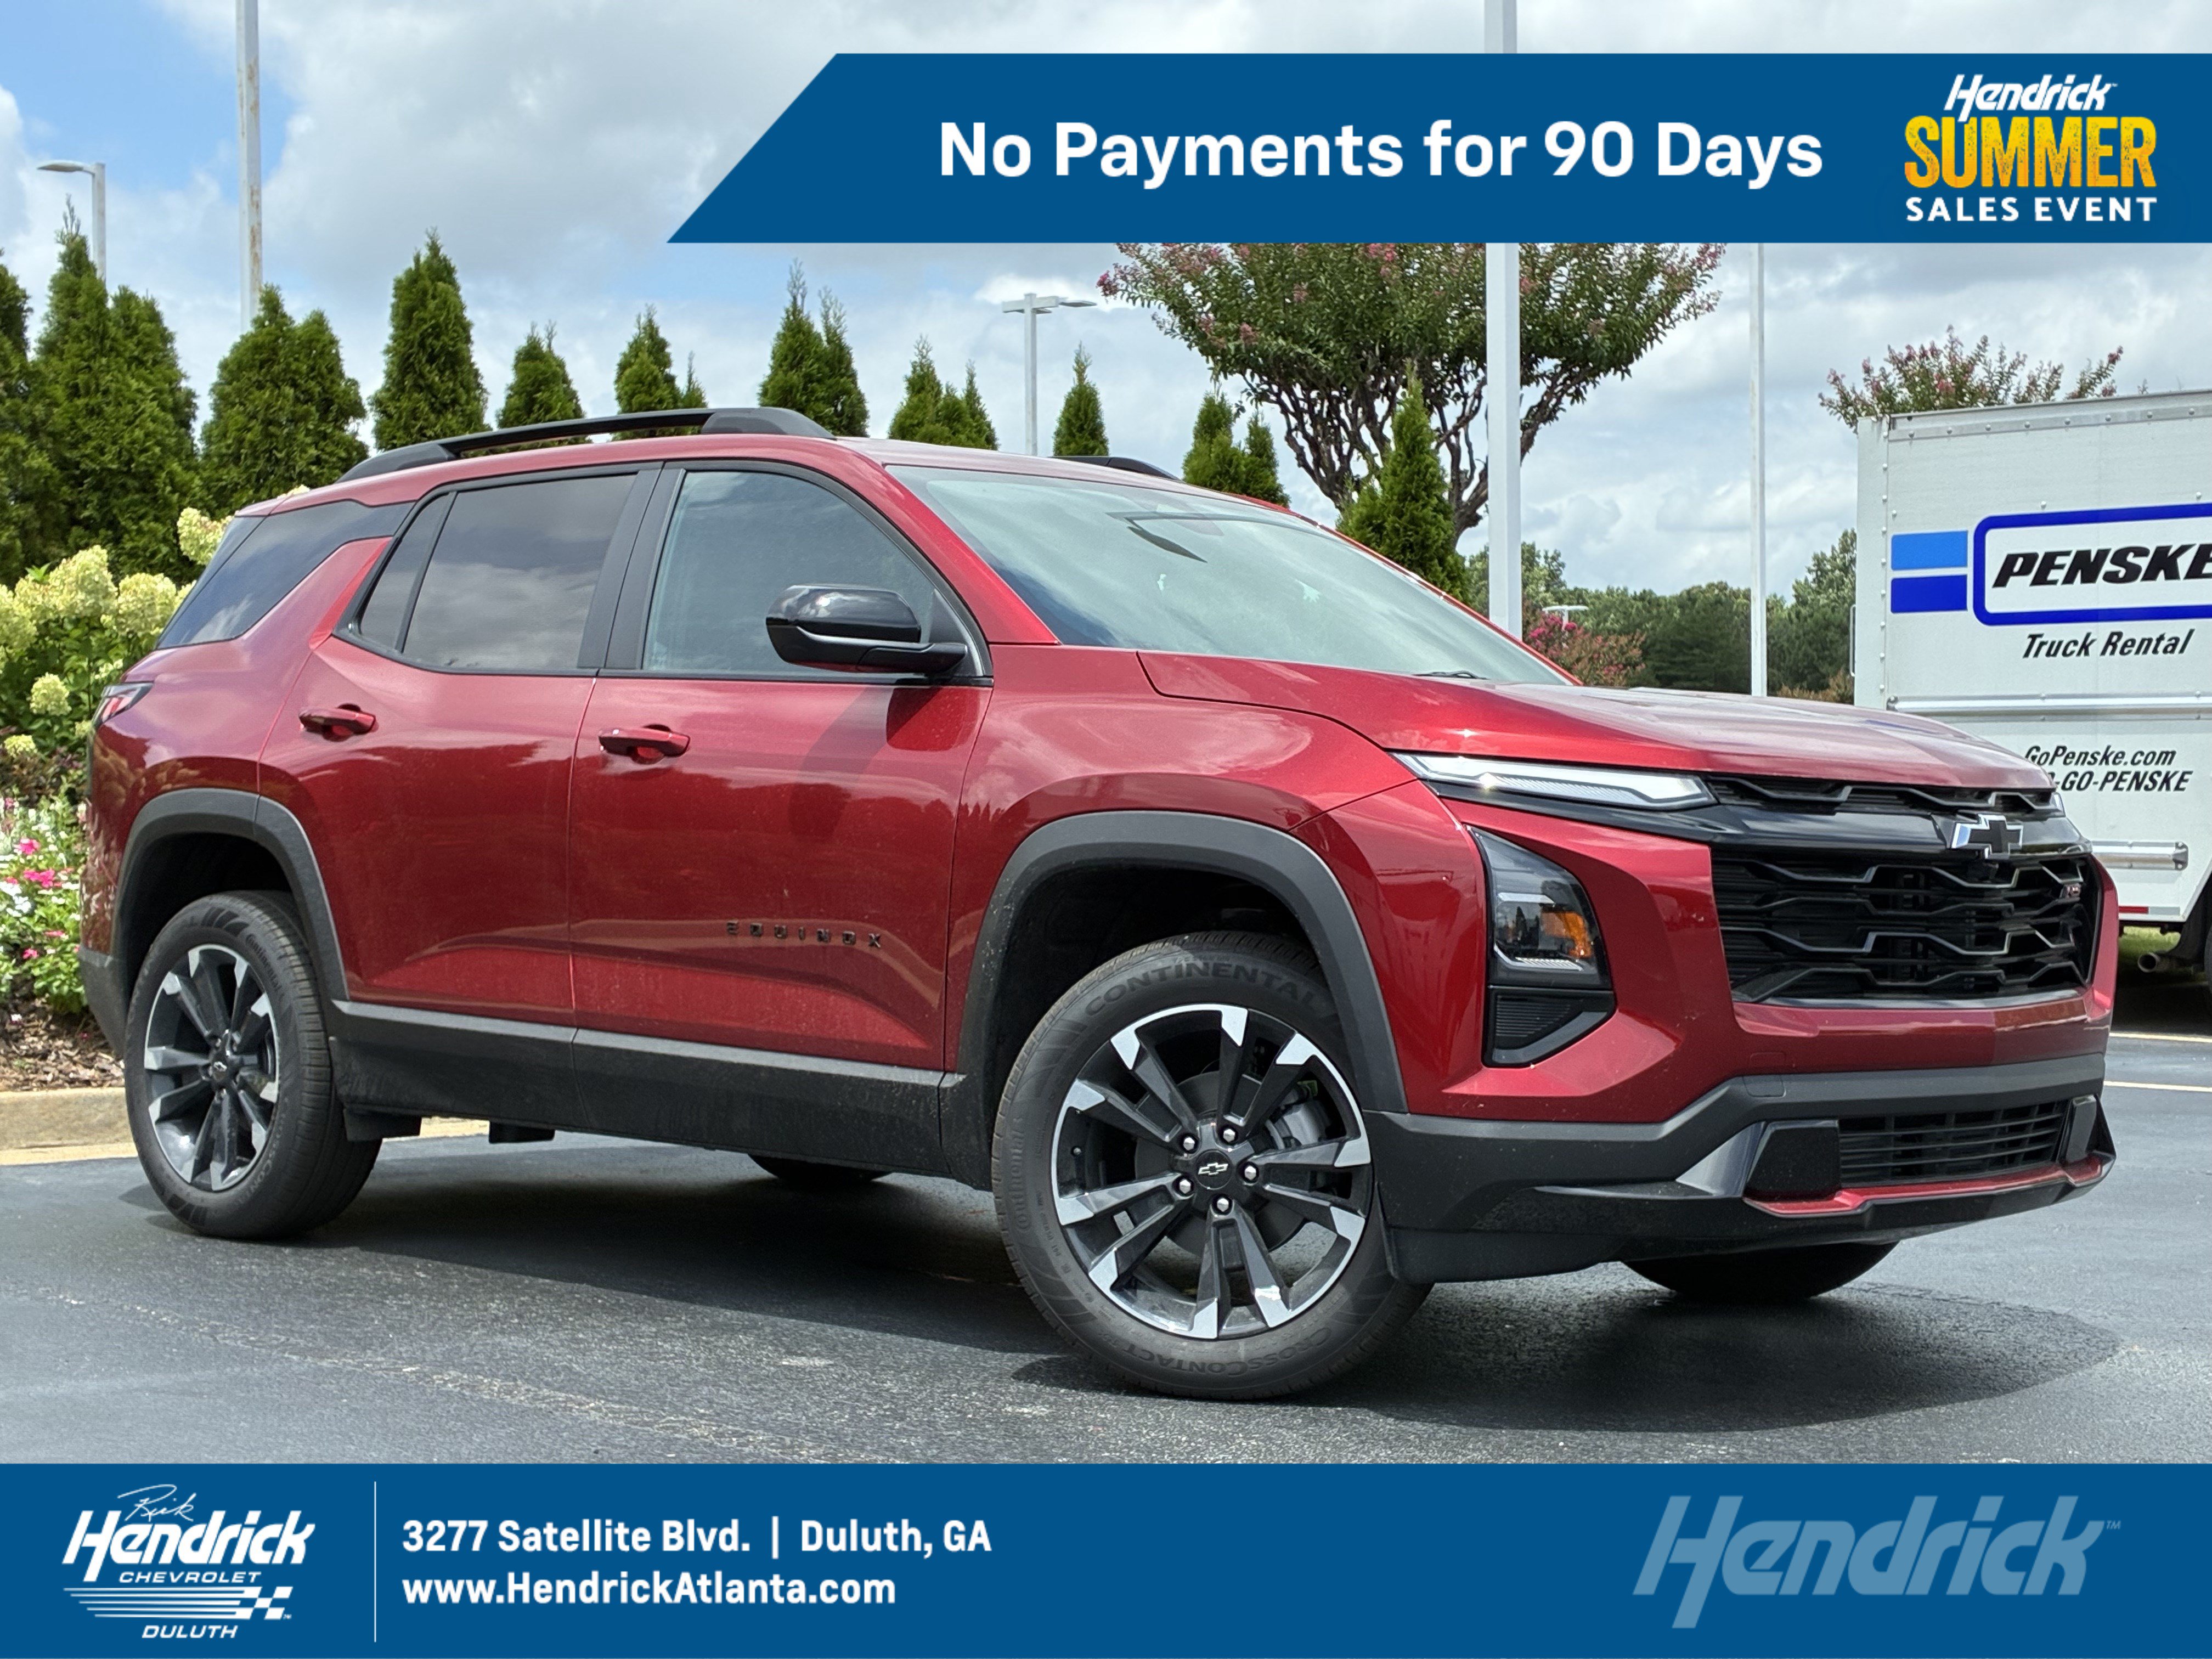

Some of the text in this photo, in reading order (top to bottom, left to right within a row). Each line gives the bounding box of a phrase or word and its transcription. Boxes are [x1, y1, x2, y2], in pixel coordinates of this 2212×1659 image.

[1992, 543, 2212, 588] PENSKE
[2022, 629, 2195, 658] Truck Rental
[2025, 744, 2177, 766] GoPenske.com
[726, 920, 881, 948] EQUINOX
[1085, 961, 1318, 1017] CONTINENTAL
